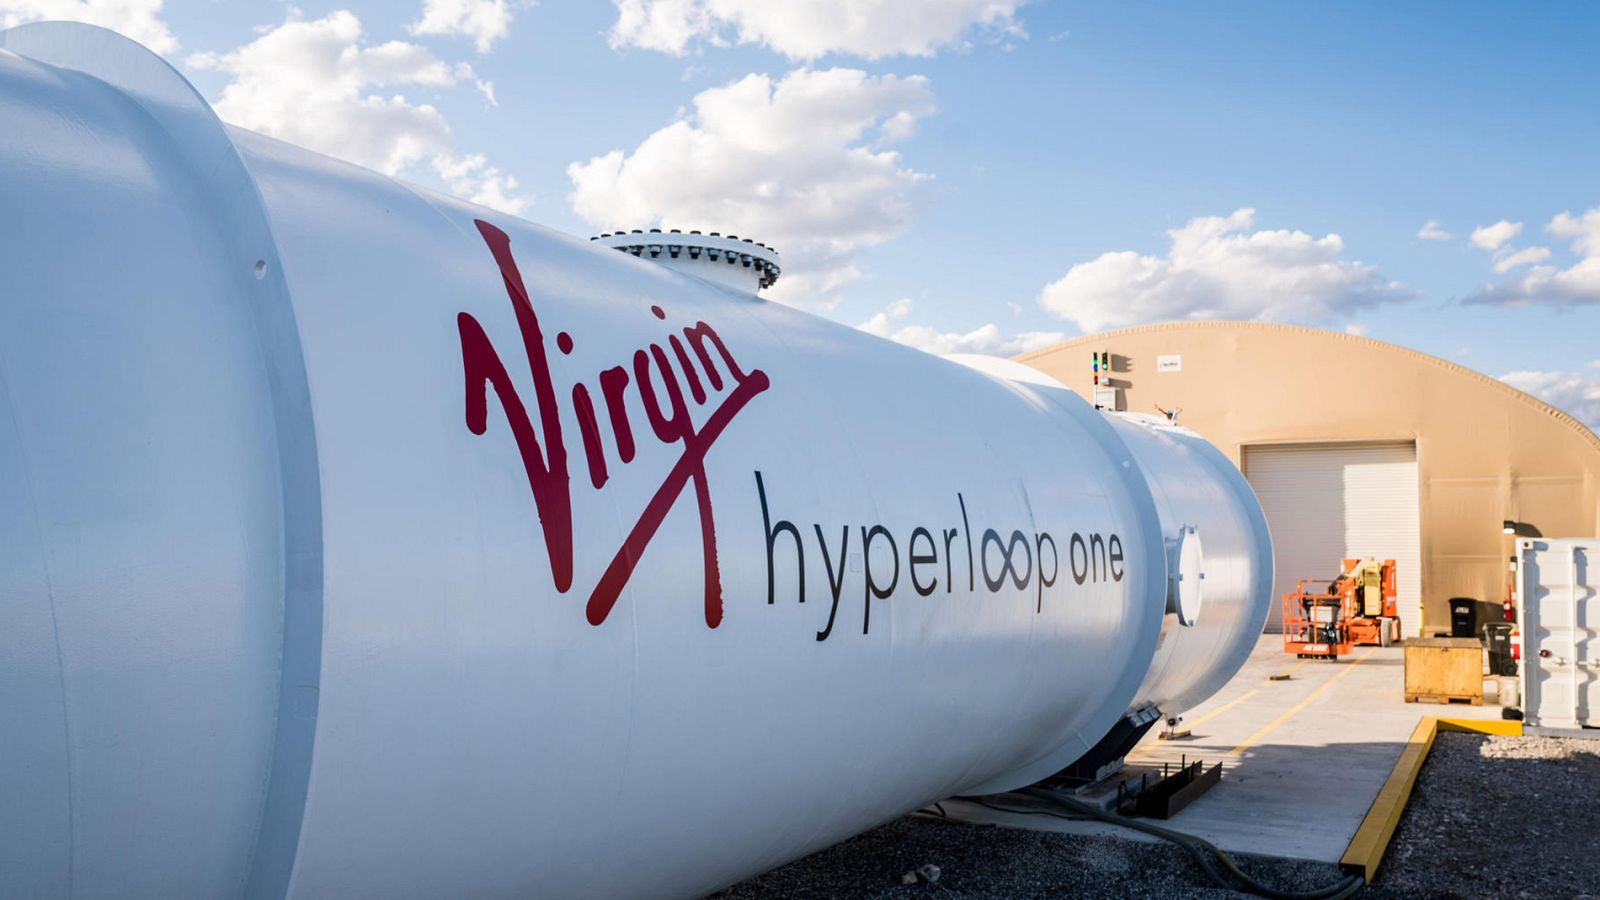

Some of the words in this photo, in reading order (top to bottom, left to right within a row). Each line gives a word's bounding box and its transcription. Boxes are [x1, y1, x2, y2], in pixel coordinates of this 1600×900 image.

[457, 218, 770, 629] Virgin
[754, 470, 1058, 642] hyperloop
[1070, 531, 1124, 585] one
